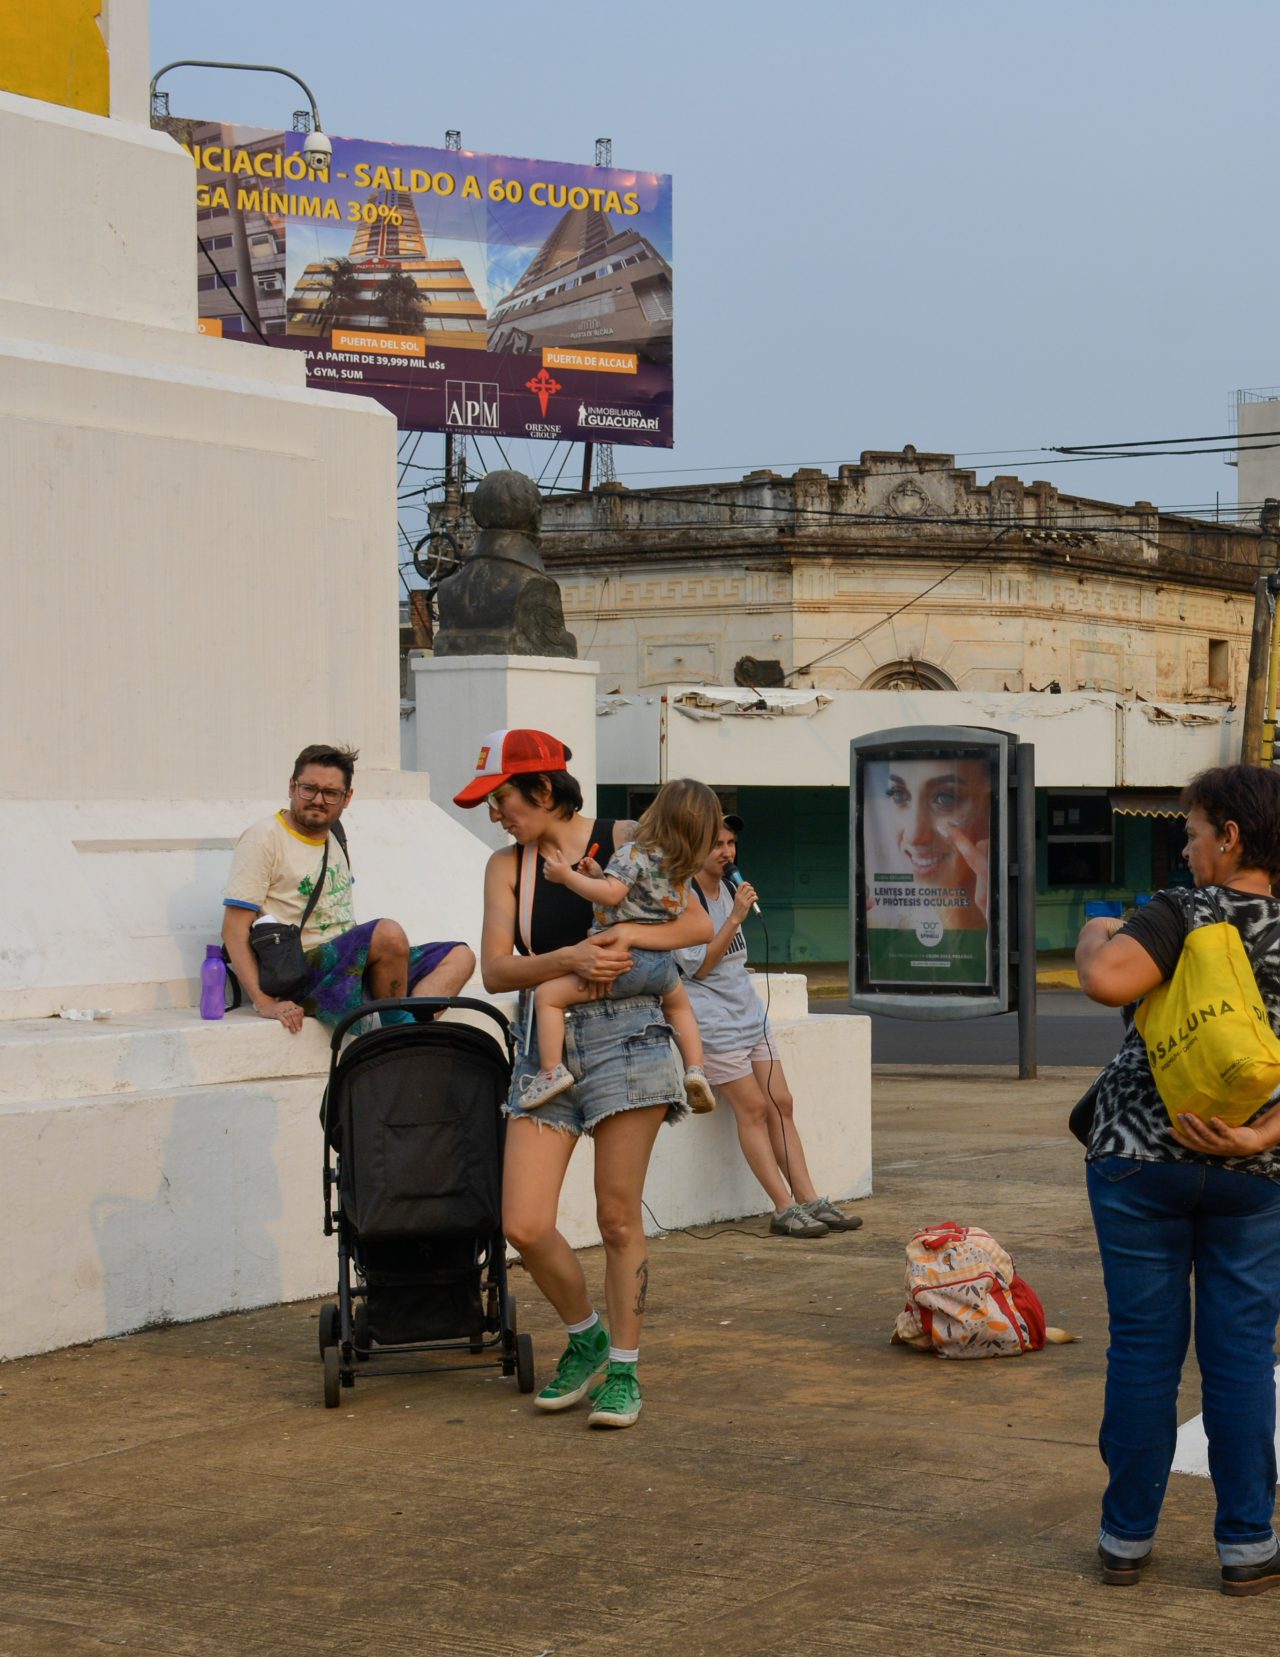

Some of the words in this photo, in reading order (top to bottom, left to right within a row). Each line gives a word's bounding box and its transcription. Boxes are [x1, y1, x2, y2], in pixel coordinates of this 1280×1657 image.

[354, 163, 455, 196] SALDO
[461, 175, 482, 200] A
[488, 179, 523, 203] 60
[529, 182, 641, 216] CUOTAS
[237, 187, 341, 220] MÍNIMA
[347, 201, 403, 226] 30%
[341, 336, 378, 348] PUERTA
[380, 339, 399, 350] DEL
[400, 341, 420, 352] SOL
[317, 352, 324, 361] A
[326, 352, 359, 364] PARTIR
[362, 354, 375, 364] DE
[376, 356, 408, 367] 39,999
[410, 358, 427, 369] MIL
[547, 353, 582, 365] PUERTA
[584, 356, 597, 366] DE
[598, 357, 634, 370] ALCALÁ
[314, 367, 340, 378] GYM,
[341, 369, 363, 380] SUM
[448, 400, 498, 428] APM
[588, 407, 642, 418] INMOBILIARIA
[525, 423, 562, 433] ORENSE
[588, 416, 659, 430] GUACURARÍ
[530, 431, 557, 439] GROUP
[874, 888, 904, 896] LENTES
[905, 888, 916, 896] DE
[918, 888, 967, 896] CONTACTO
[875, 898, 882, 906] Y
[923, 898, 971, 907] OCULARES
